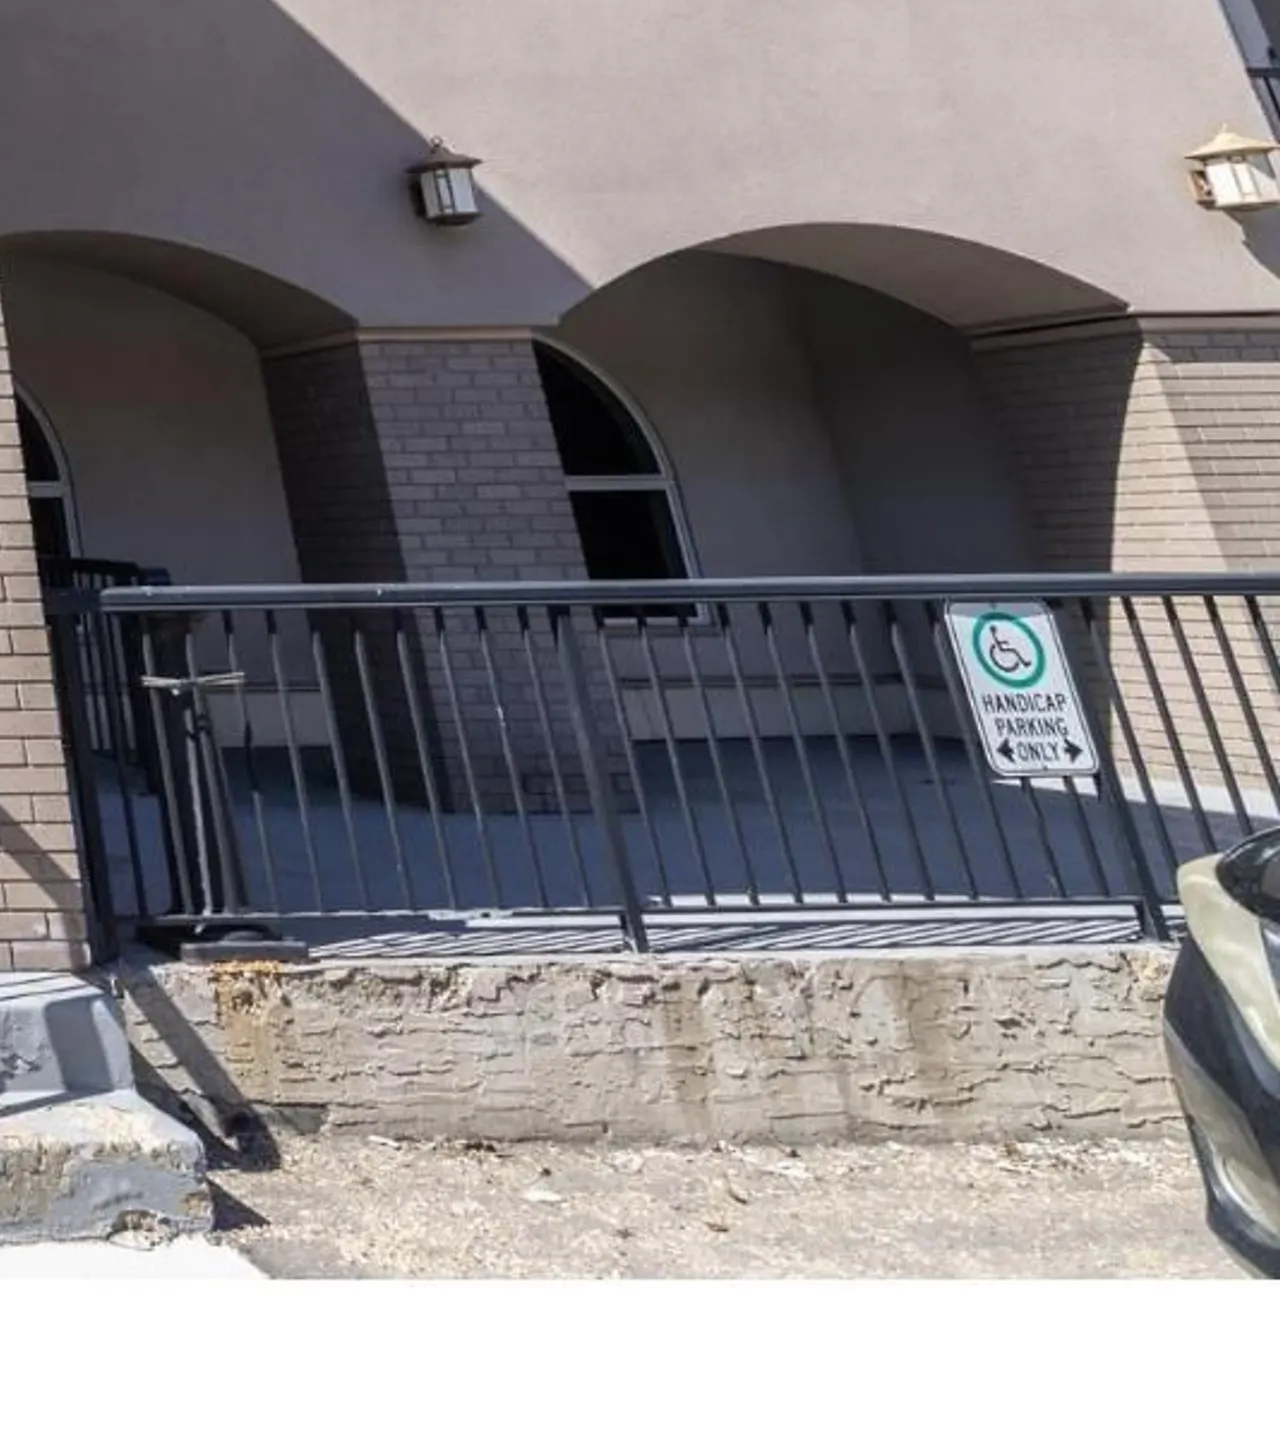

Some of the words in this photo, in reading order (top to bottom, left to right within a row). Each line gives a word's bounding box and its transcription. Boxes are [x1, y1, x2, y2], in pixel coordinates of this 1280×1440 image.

[981, 693, 1067, 713] HANDICAP
[994, 717, 1069, 737] PARKING
[1016, 741, 1060, 761] ONLY
